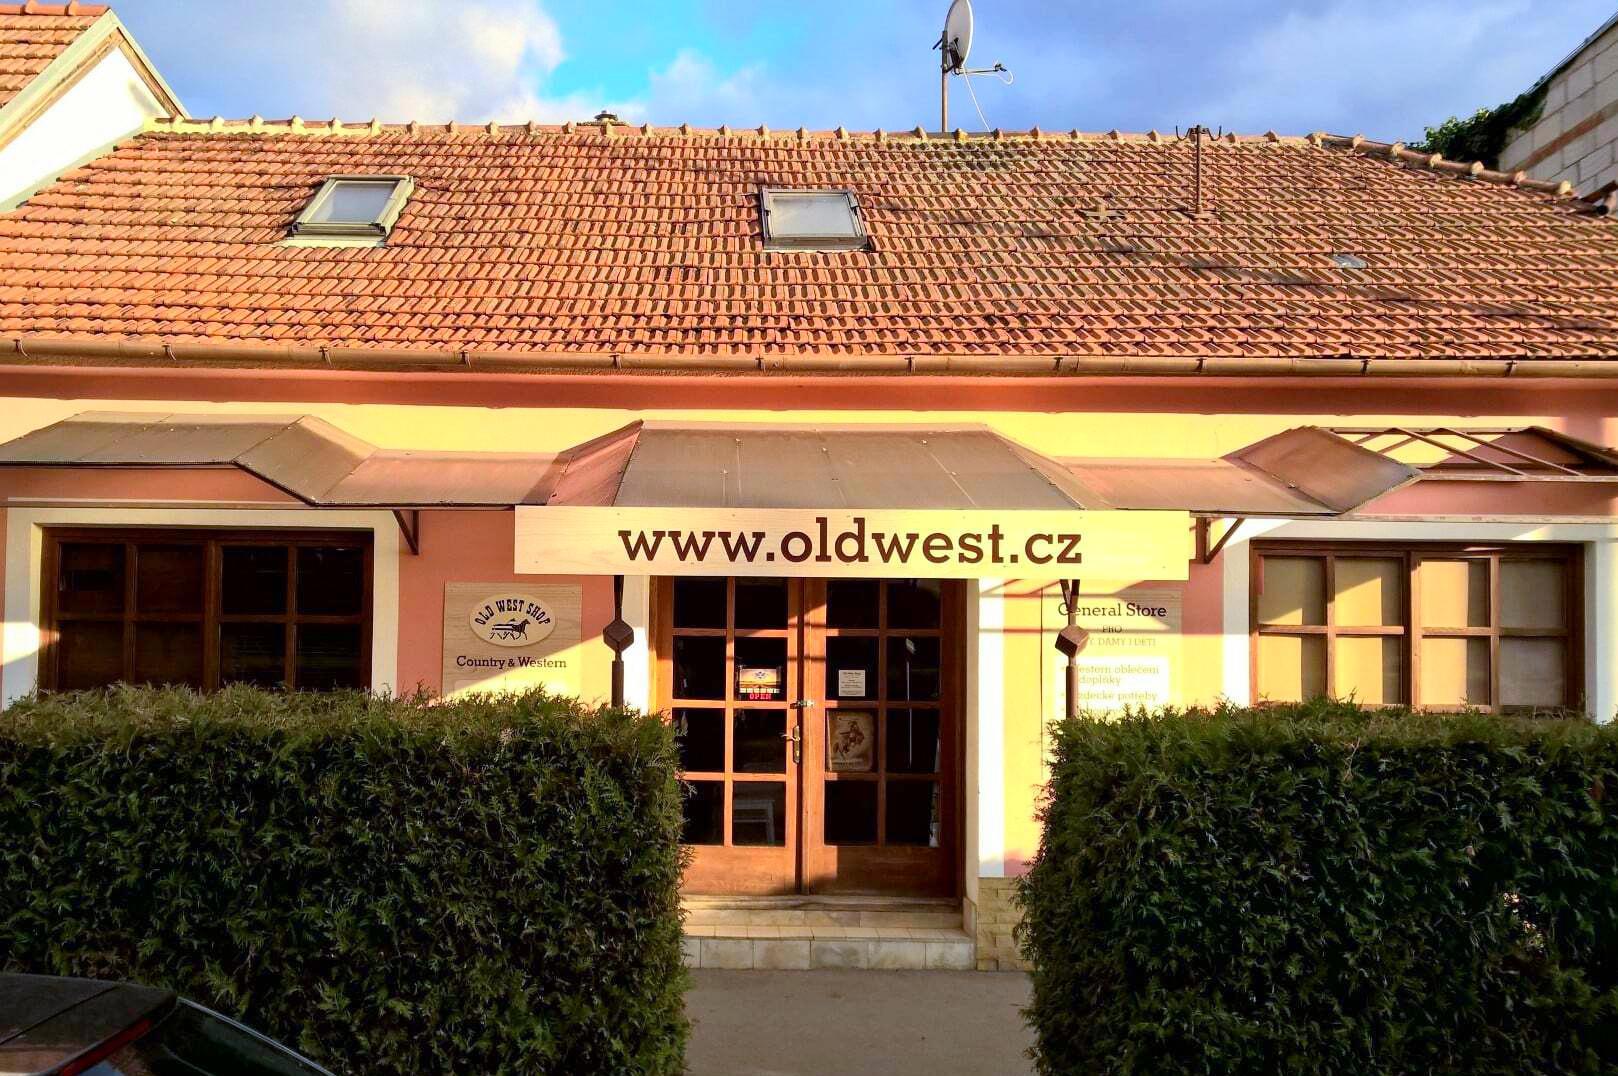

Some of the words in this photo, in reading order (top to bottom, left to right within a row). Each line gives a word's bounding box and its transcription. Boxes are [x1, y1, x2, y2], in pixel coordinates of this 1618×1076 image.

[618, 516, 1083, 564] www.oldwest.cz
[474, 605, 495, 625] OLD
[495, 599, 525, 613] WEST
[526, 602, 551, 625] SHOP
[1058, 602, 1122, 617] General
[1126, 602, 1168, 617] Store
[1102, 624, 1123, 634] PRO
[456, 655, 506, 670] Country
[507, 658, 515, 667] &
[518, 656, 567, 668] Western
